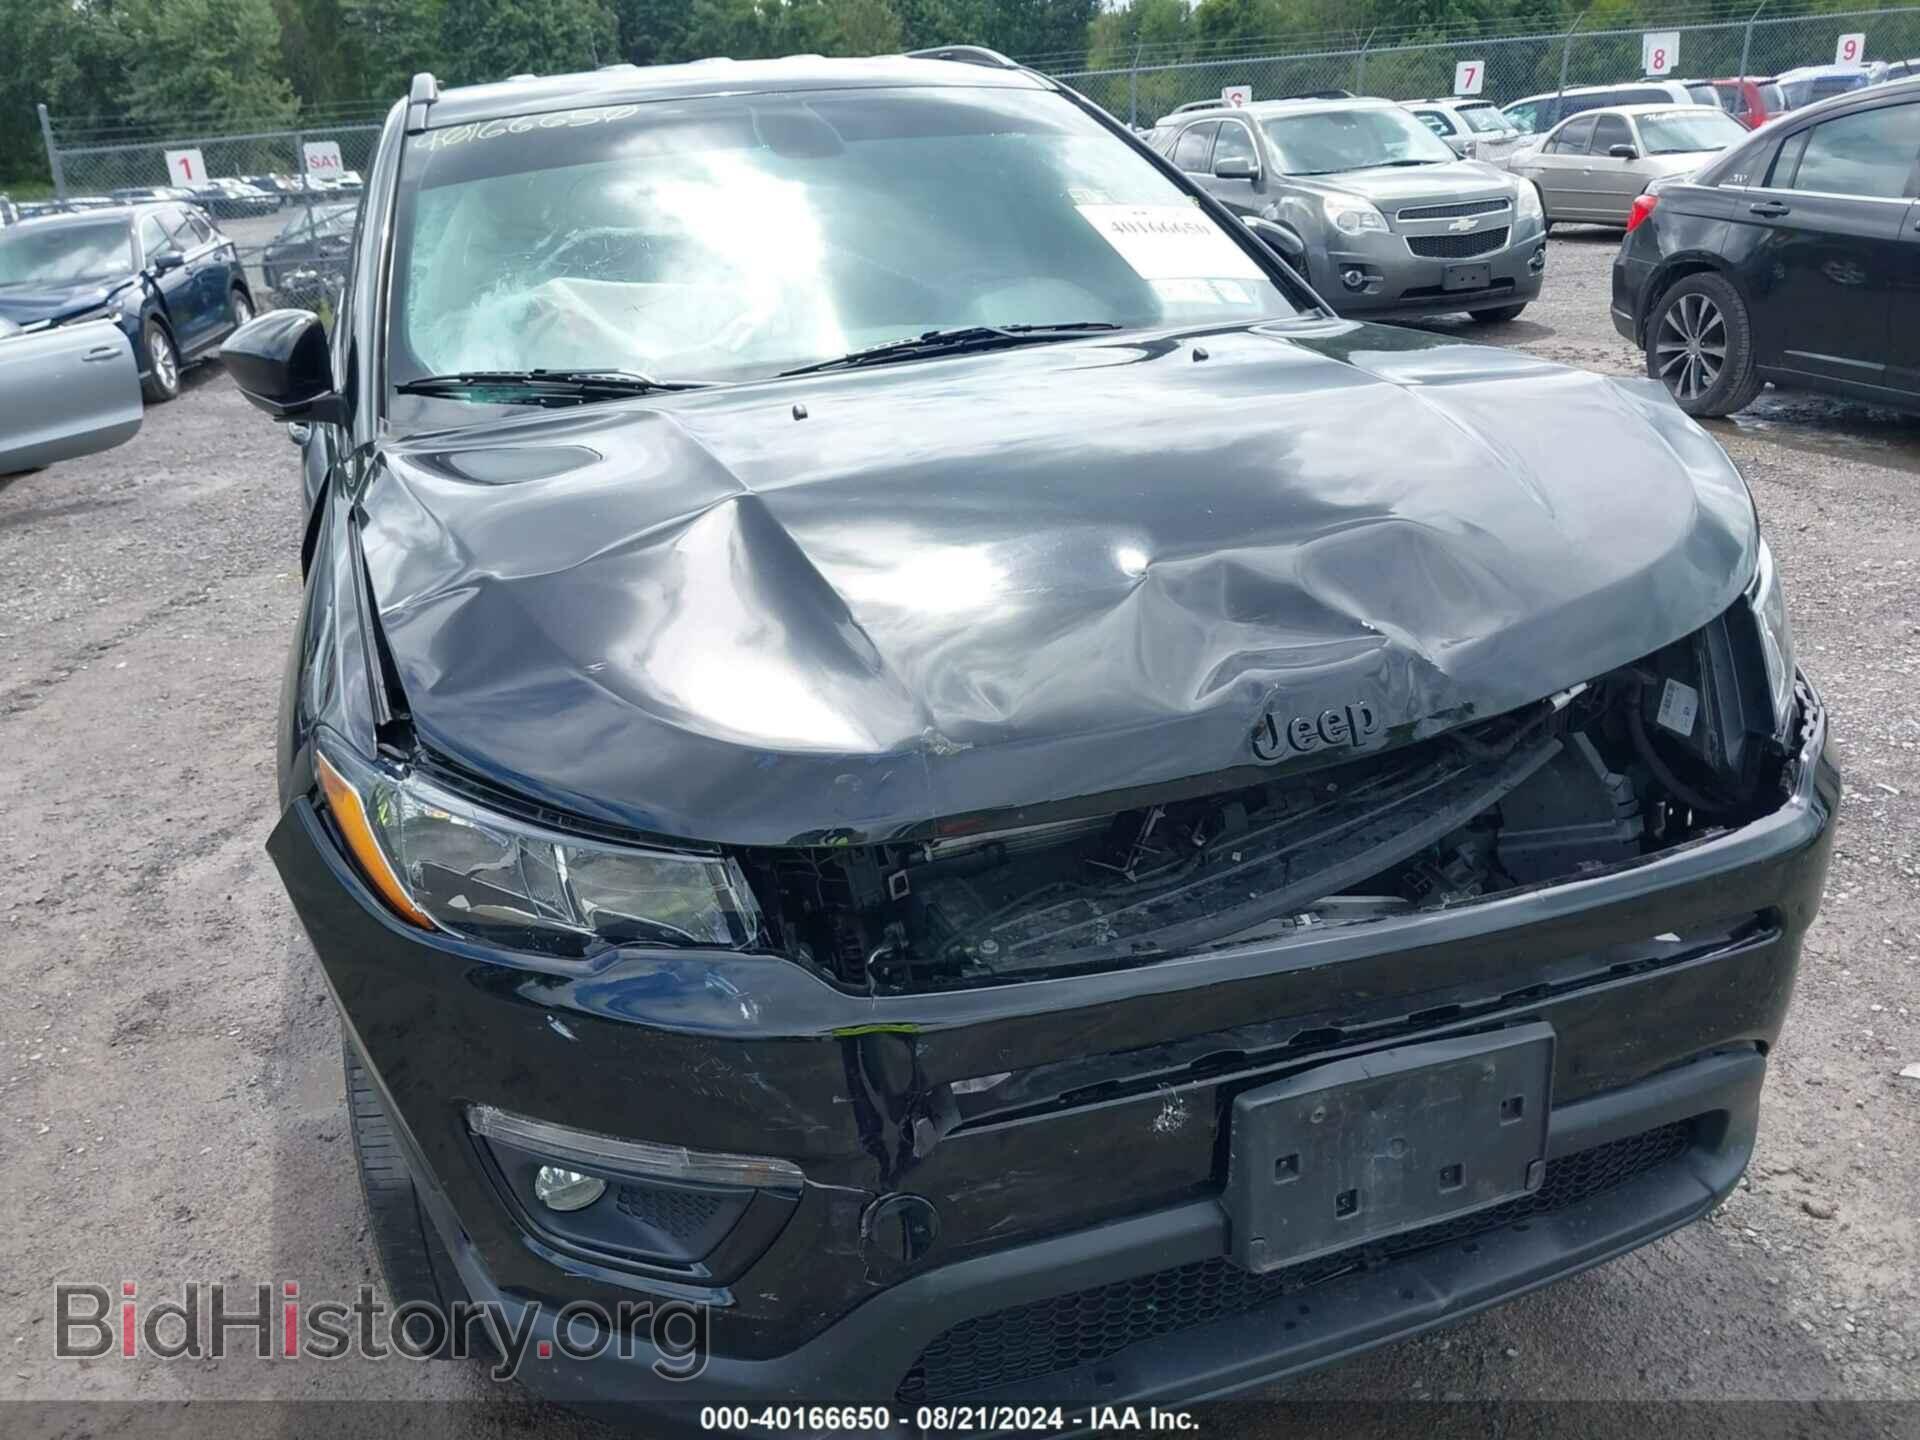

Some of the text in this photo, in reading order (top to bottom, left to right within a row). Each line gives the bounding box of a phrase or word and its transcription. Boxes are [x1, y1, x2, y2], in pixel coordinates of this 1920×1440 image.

[1654, 49, 1665, 69] 8
[1843, 39, 1856, 60] 9
[1464, 67, 1476, 89] 7
[178, 157, 192, 180] 1
[309, 156, 339, 169] SA1
[1252, 701, 1381, 760] Jeep
